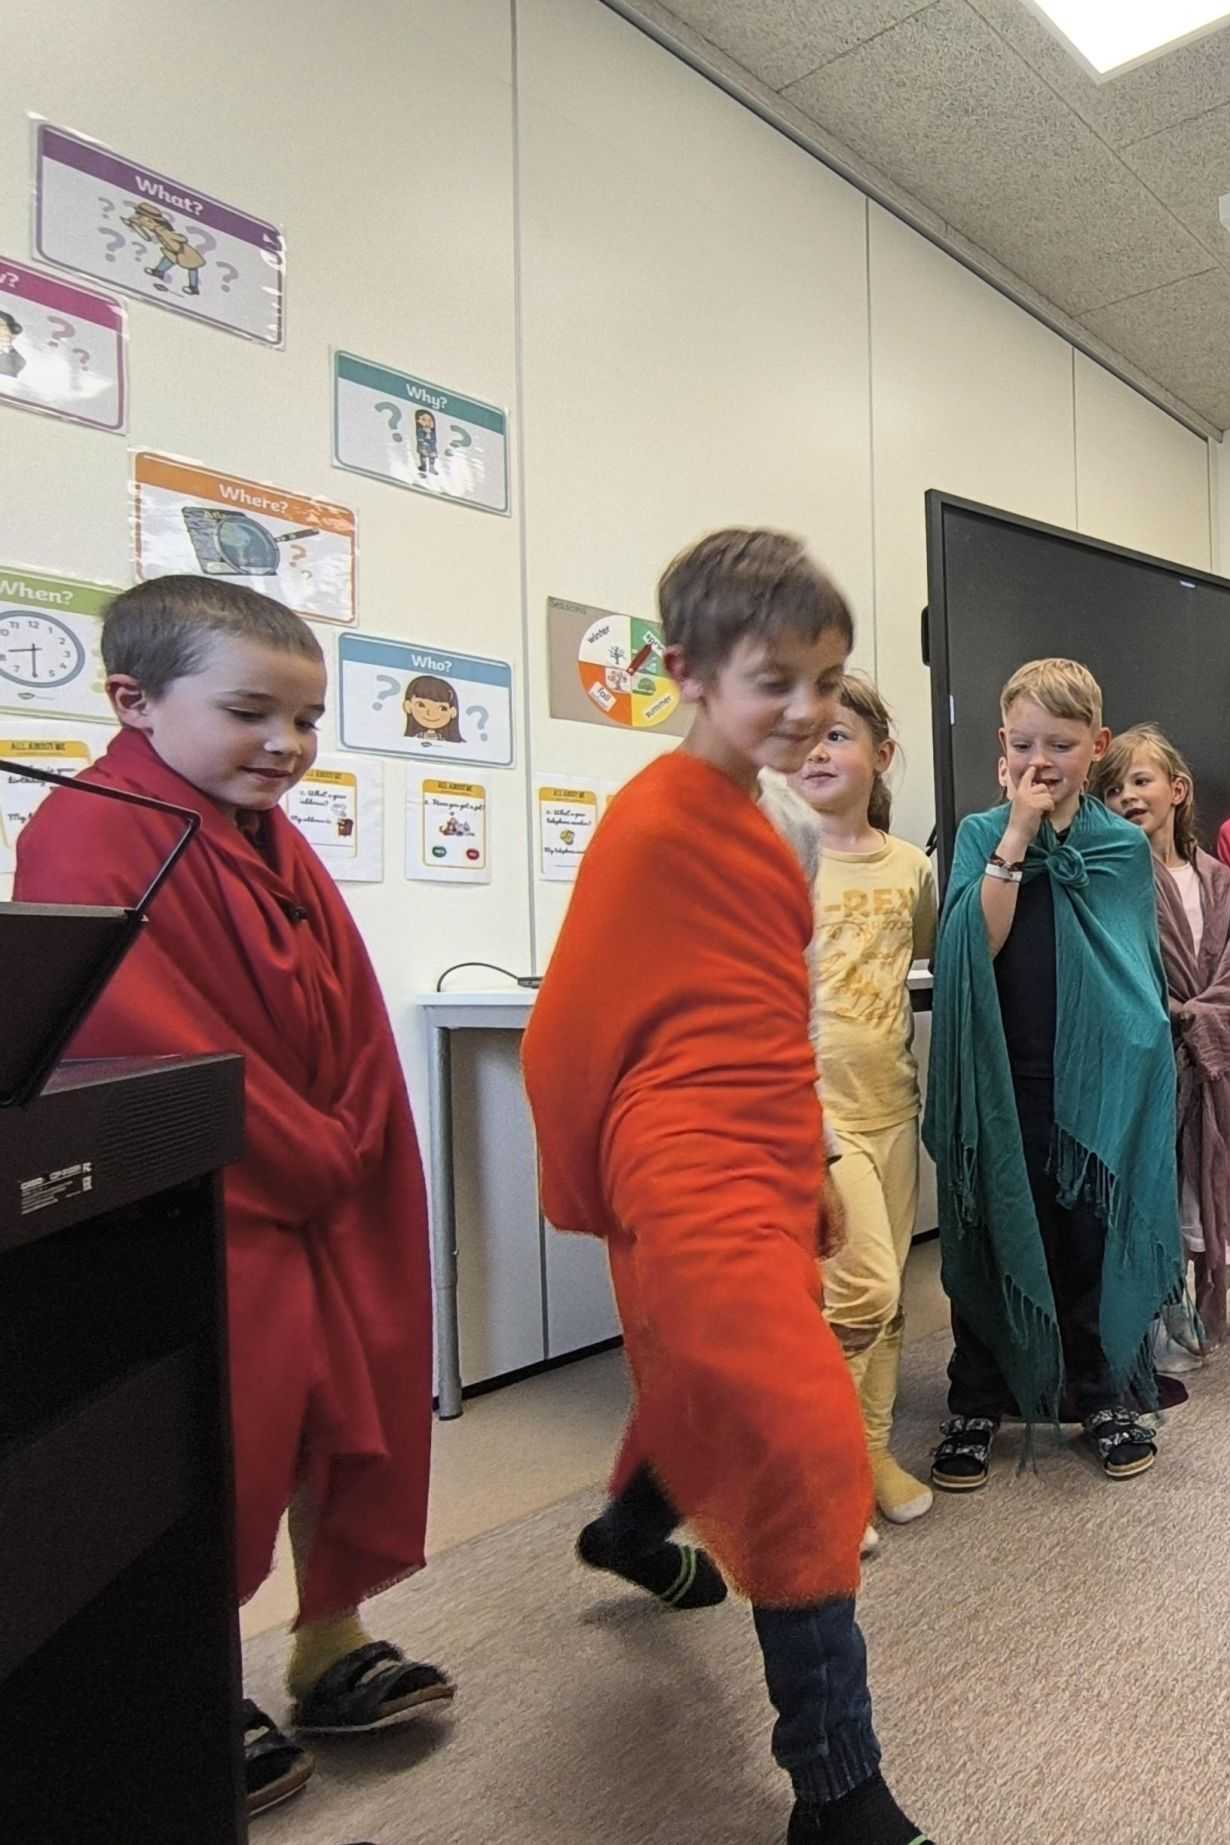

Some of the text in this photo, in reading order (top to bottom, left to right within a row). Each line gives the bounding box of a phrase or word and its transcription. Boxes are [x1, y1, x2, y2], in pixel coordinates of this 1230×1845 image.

[135, 175, 203, 216] What?
[405, 383, 448, 409] Why?
[218, 484, 289, 513] Where?
[0, 580, 73, 605] When?
[587, 625, 611, 644] winter
[411, 654, 453, 672] Who?
